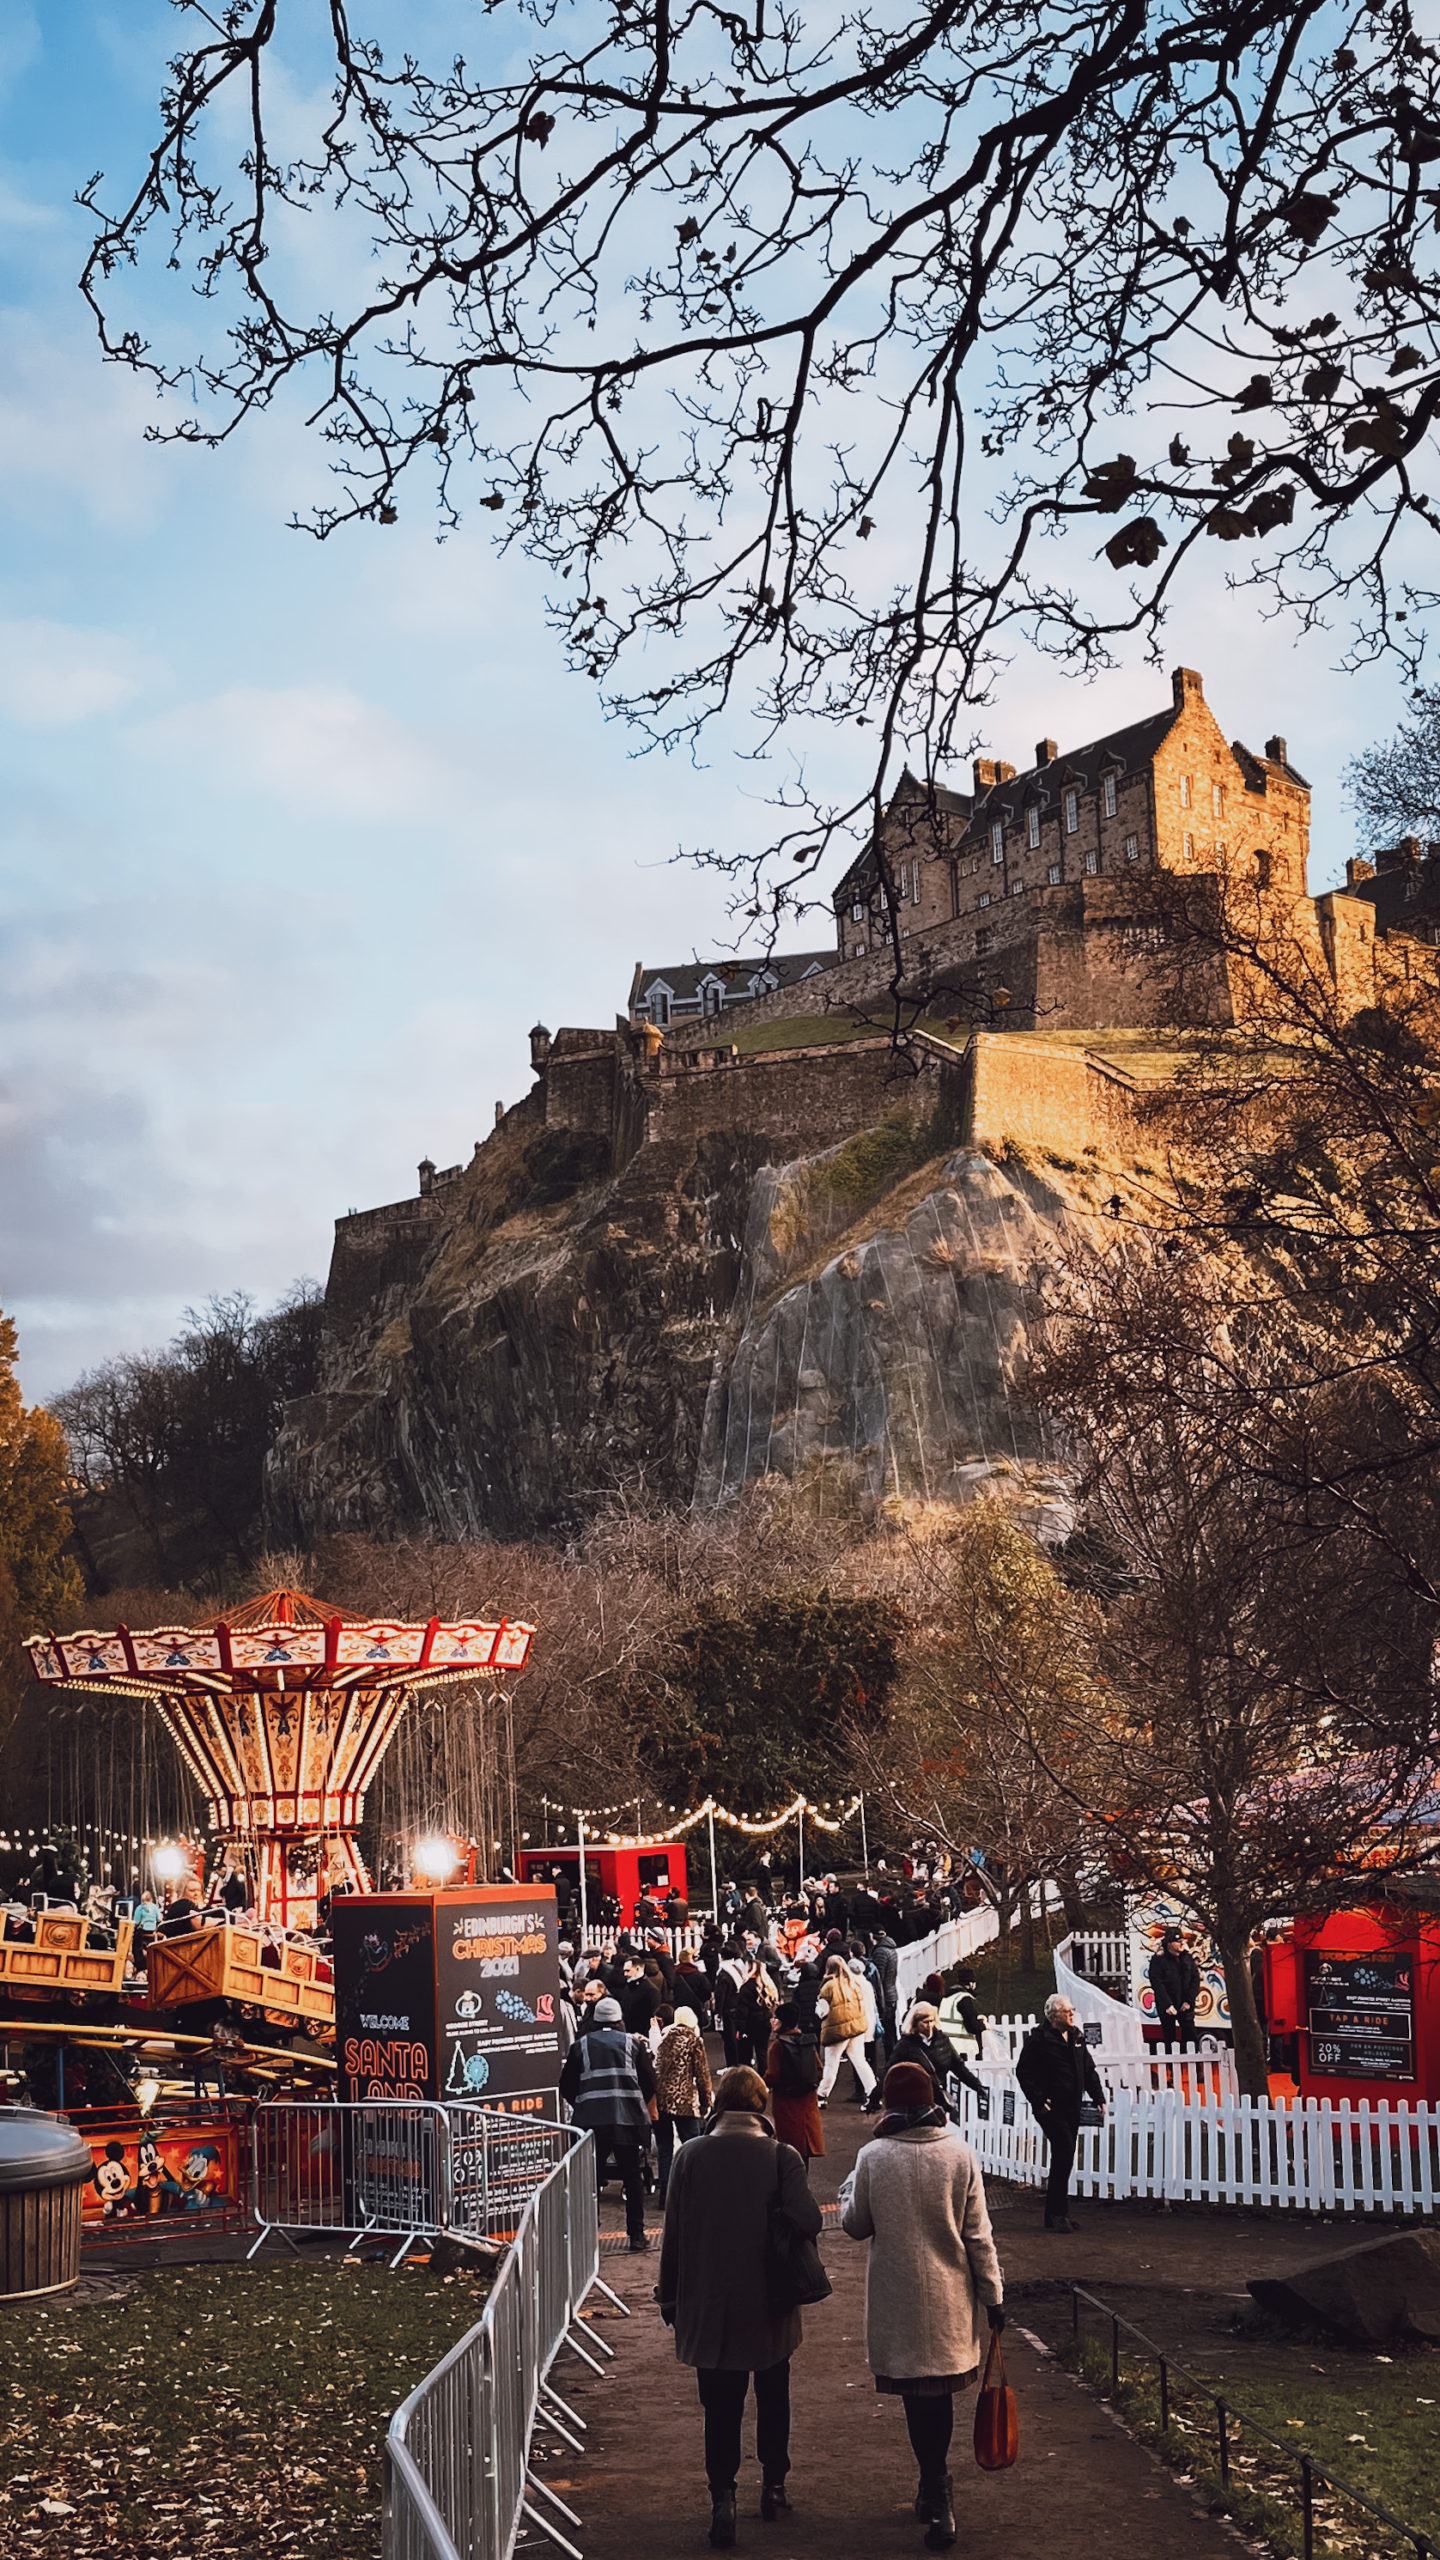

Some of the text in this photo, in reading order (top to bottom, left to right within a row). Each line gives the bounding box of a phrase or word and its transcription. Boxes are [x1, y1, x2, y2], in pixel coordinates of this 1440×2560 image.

[464, 1914, 535, 1938] EDINBURGH'S
[452, 1933, 548, 1960] CHRISTMAS
[480, 1956, 519, 1978] 2021
[360, 2013, 410, 2031] WELCOME
[1329, 2014, 1348, 2022] TAP
[1363, 2016, 1388, 2025] RIDE
[1318, 2043, 1341, 2053] 20%
[344, 2038, 428, 2080] SANTA
[1318, 2053, 1341, 2063] OFF
[511, 2096, 544, 2112] RIDE
